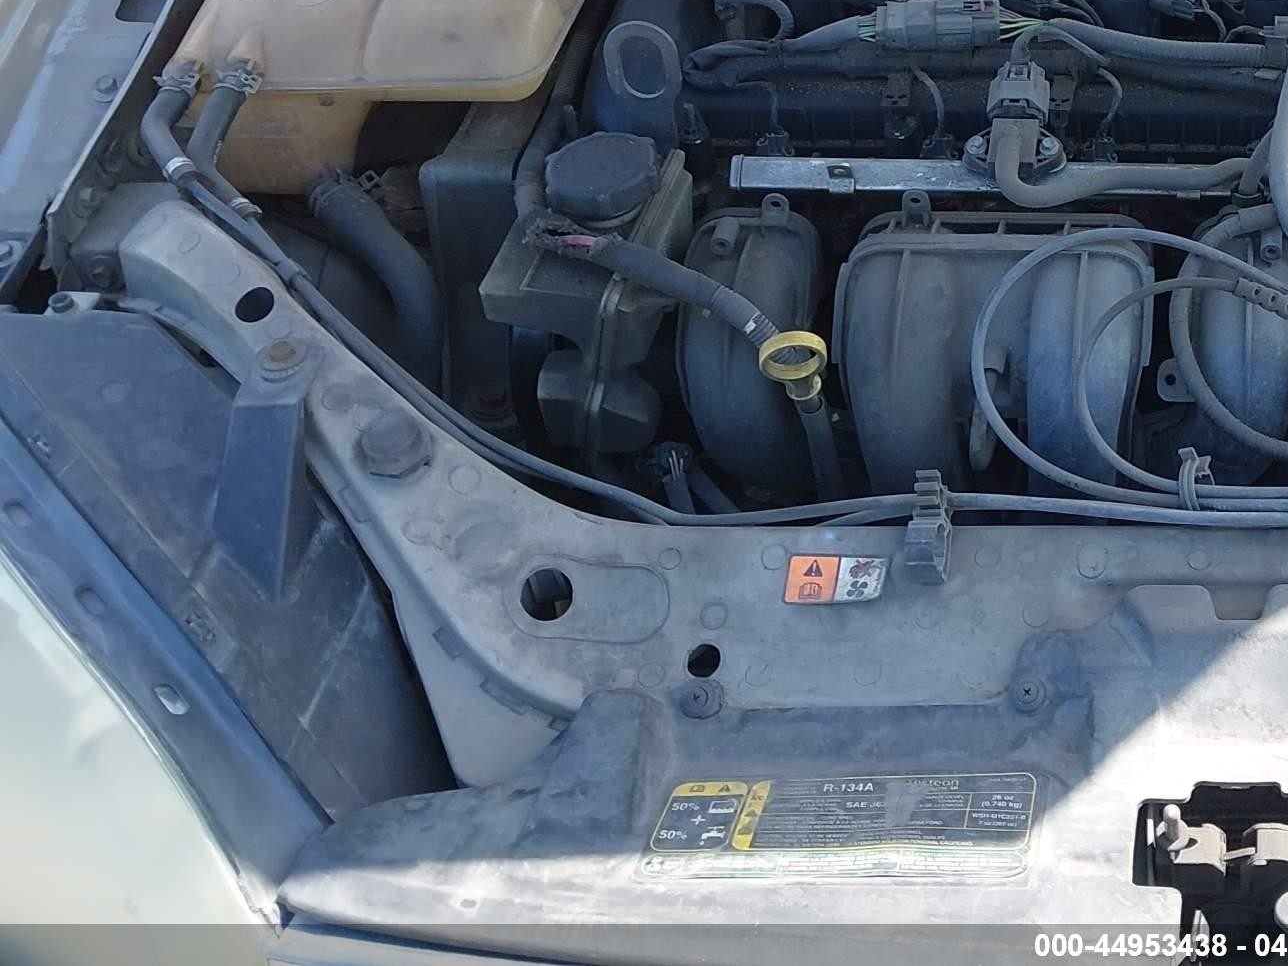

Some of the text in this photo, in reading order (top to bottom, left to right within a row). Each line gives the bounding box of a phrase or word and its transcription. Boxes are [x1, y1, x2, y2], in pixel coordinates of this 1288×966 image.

[823, 782, 874, 793] R-134A
[671, 802, 700, 811] 50%
[845, 801, 867, 809] SAE
[658, 830, 688, 840] 50%
